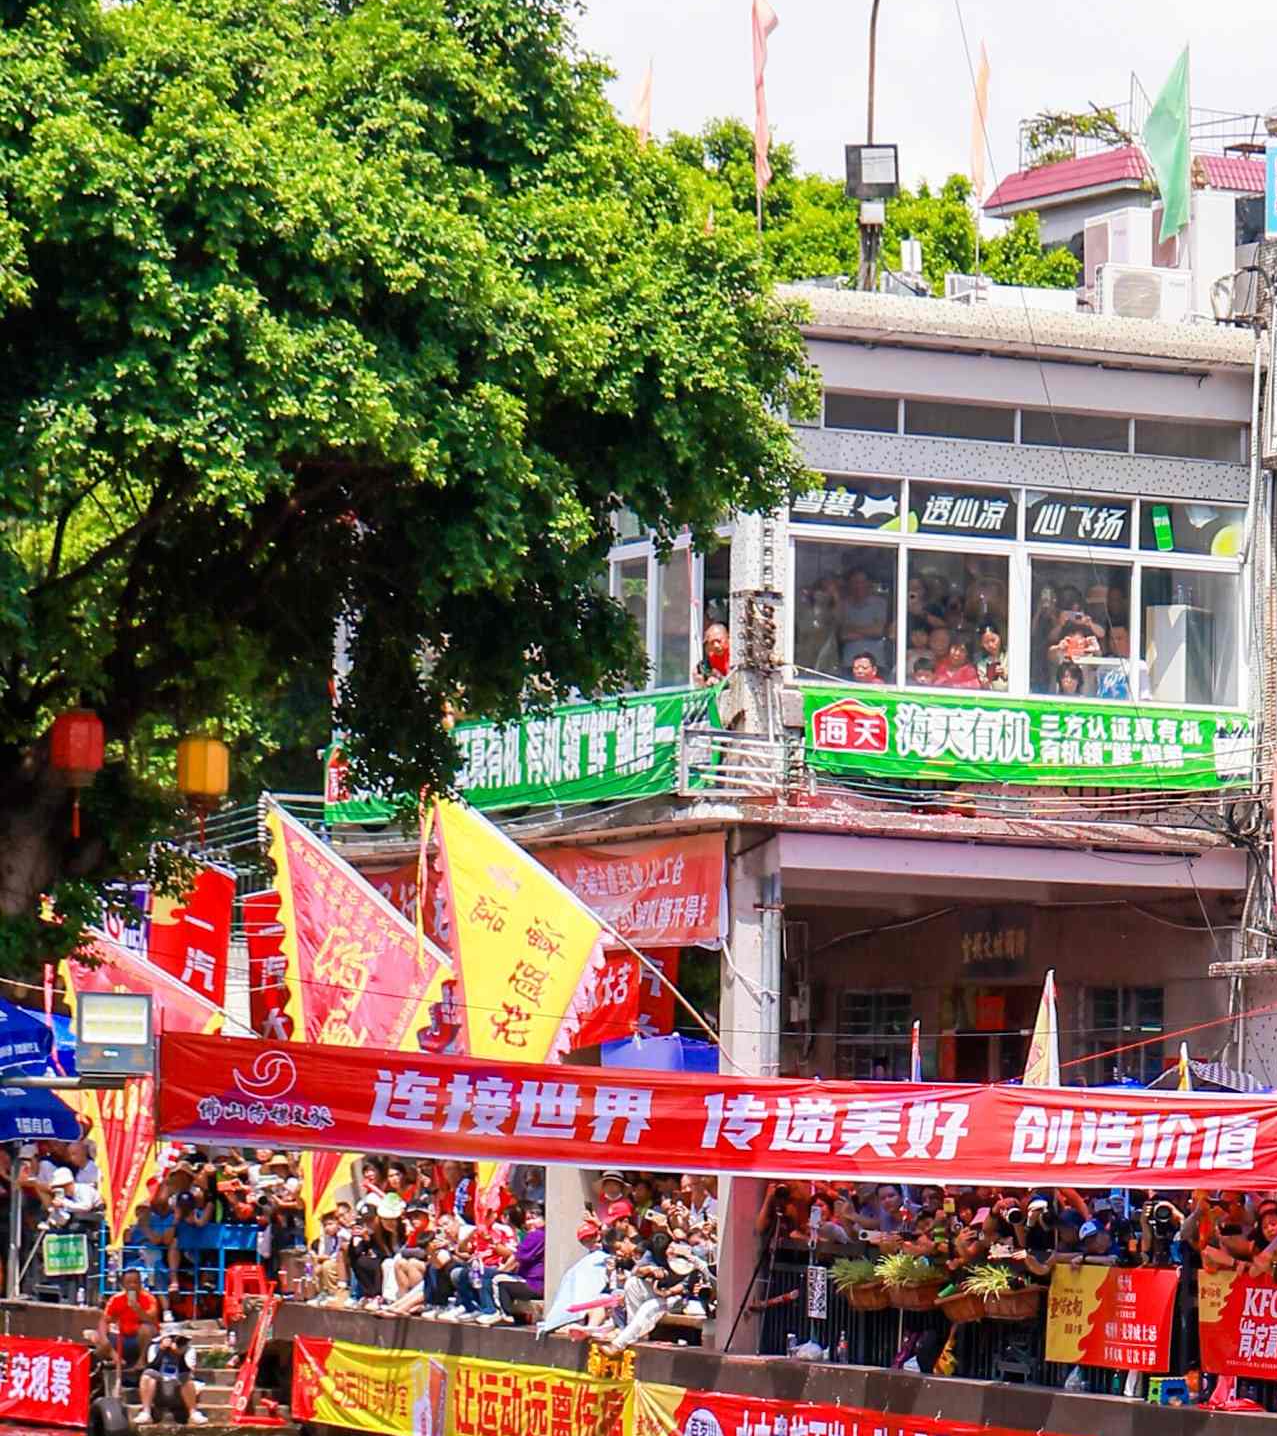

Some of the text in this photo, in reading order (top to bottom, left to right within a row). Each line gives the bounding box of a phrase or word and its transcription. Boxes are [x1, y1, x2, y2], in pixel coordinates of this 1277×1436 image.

[920, 495, 1009, 532] 透心凉
[1031, 504, 1127, 542] 心飞扬
[818, 715, 884, 748] 海天
[895, 702, 1035, 764] 海天有机
[1038, 713, 1204, 746] 三方认证真有机
[369, 1068, 1259, 1171] 连接世界 传递美好 创造价值
